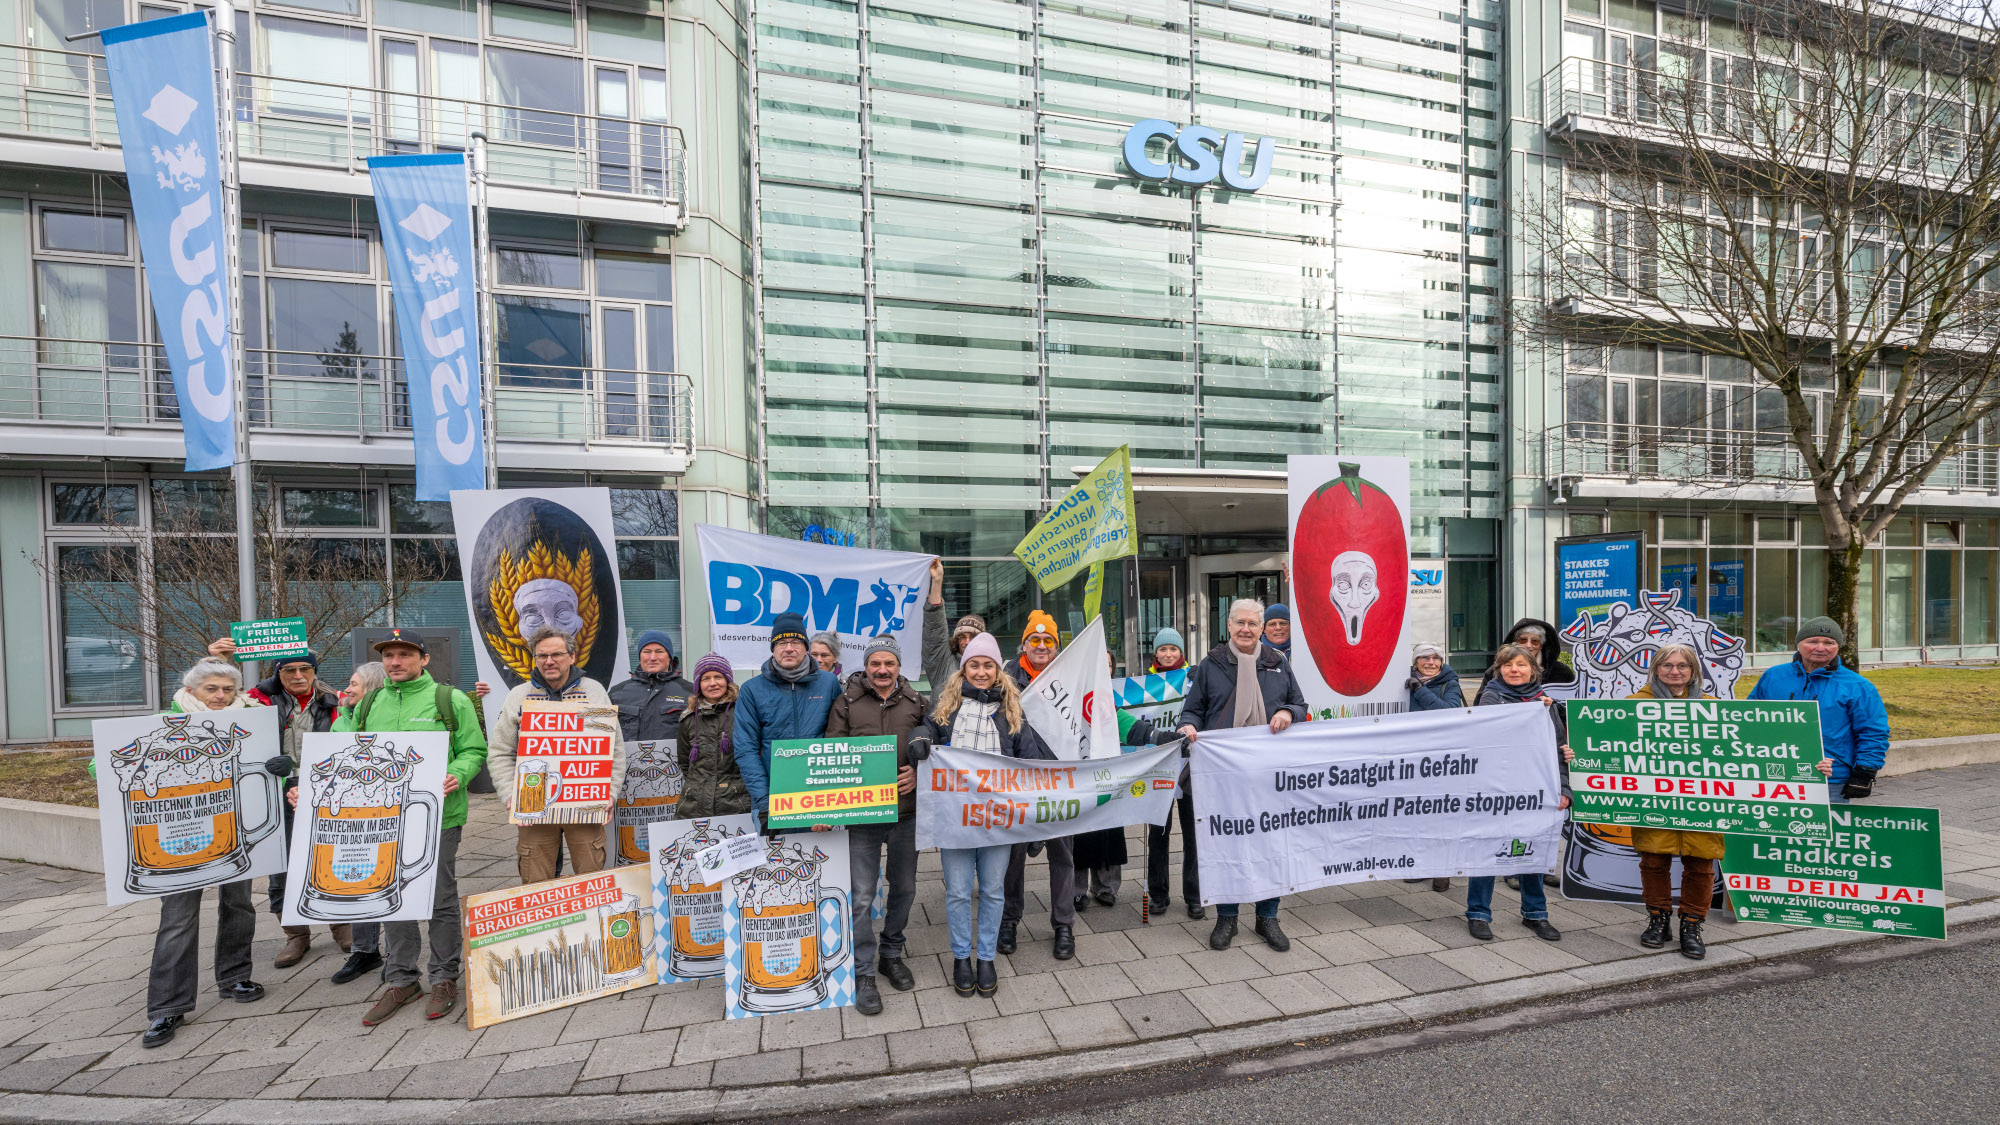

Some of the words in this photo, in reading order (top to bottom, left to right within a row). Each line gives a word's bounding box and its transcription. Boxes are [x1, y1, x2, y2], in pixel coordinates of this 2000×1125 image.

[1123, 118, 1276, 193] CSU
[1564, 559, 1610, 570] STARKES
[1564, 569, 1610, 580] BAYERN.
[1564, 580, 1604, 589] STARKE
[708, 560, 860, 635] BDM
[1564, 588, 1631, 600] KOMMUNEN.
[239, 634, 299, 645] Landkreis
[247, 627, 290, 637] FREIER
[239, 649, 304, 659] www.zivilcourage.ro
[259, 643, 284, 651] DEIN
[530, 713, 578, 730] KEIN
[1637, 722, 1740, 740] FREIER
[526, 738, 605, 755] PATENT
[1586, 736, 1701, 756] Landkreis
[1711, 745, 1725, 757] &
[1731, 740, 1800, 759] Stadt
[807, 754, 862, 767] FREIER
[1623, 754, 1760, 779] München
[564, 762, 600, 777] AUF
[809, 767, 859, 776] Landkreis
[1094, 768, 1111, 782] LVÖ
[1275, 769, 1324, 792] Unser
[1328, 759, 1395, 787] Saatgut
[1399, 758, 1415, 780] in
[1420, 753, 1478, 778] Gefahr
[805, 776, 863, 785] Starnberg
[931, 768, 969, 792] DIE
[976, 766, 1077, 792] ZUKUNFT
[563, 785, 607, 801] BIER!
[1586, 775, 1639, 791] GIB
[1654, 778, 1735, 797] DEIN
[1751, 782, 1807, 801] JA!
[133, 796, 193, 814] GENTECHNIK
[195, 795, 207, 806] IM
[209, 789, 232, 805] BIER!
[774, 797, 793, 811] IN
[800, 790, 874, 809] GEFAHR
[880, 788, 894, 801] !!!
[1580, 794, 1814, 820] www.zivilcourage.ro
[133, 813, 162, 825] WILLST
[164, 812, 175, 823] DU
[177, 810, 192, 821] DAS
[193, 801, 233, 818] WIRKLICH?
[620, 807, 657, 818] GENTECHNIK
[657, 806, 665, 814] IM
[772, 809, 894, 821] www.zivilcourage-starnberg.de
[962, 798, 1029, 830] IS(S)T
[1209, 814, 1255, 836] Neue
[1259, 802, 1353, 832] Gentechnik
[1357, 798, 1388, 820] und
[1393, 794, 1461, 816] Patente
[1464, 789, 1545, 816] stoppen!
[318, 819, 365, 833] GENTECHNIK
[366, 819, 377, 832] IM
[378, 816, 398, 831] BIER!
[620, 818, 637, 826] WILLST
[638, 817, 645, 826] DU
[1669, 816, 1713, 828] Tollwood
[317, 833, 340, 844] WILLST
[340, 834, 349, 844] DU
[350, 834, 363, 844] DAS
[363, 831, 397, 844] WIRKLICH?
[1752, 843, 1892, 869] Landkreis
[1322, 854, 1415, 876] www.abl-ev.de
[1784, 863, 1858, 881] Ebersberg
[1728, 874, 1771, 890] GIB
[1787, 879, 1859, 898] DEIN
[1875, 886, 1924, 904] JA!
[473, 897, 518, 920] KEINE
[522, 885, 582, 908] PATENTE
[585, 876, 613, 893] AUF
[673, 894, 713, 906] GENTECHNIK
[1748, 893, 1901, 915] www.zivilcourage.ro
[475, 903, 569, 936] BRAUGERSTE
[571, 901, 583, 912] &
[585, 890, 620, 908] BIER!
[674, 905, 693, 916] WILLST
[694, 905, 701, 915] DU
[701, 904, 712, 914] DAS
[745, 916, 786, 931] GENTECHNIK
[787, 916, 797, 928] IM
[798, 912, 814, 926] BIER!
[477, 936, 493, 946] Jetzt
[494, 931, 519, 943] handeln
[526, 925, 544, 935] bevor
[560, 918, 574, 927] spät
[745, 932, 762, 942] WILLST
[764, 931, 773, 941] DU
[775, 930, 786, 940] DAS
[786, 926, 815, 939] WIRKLICH?
